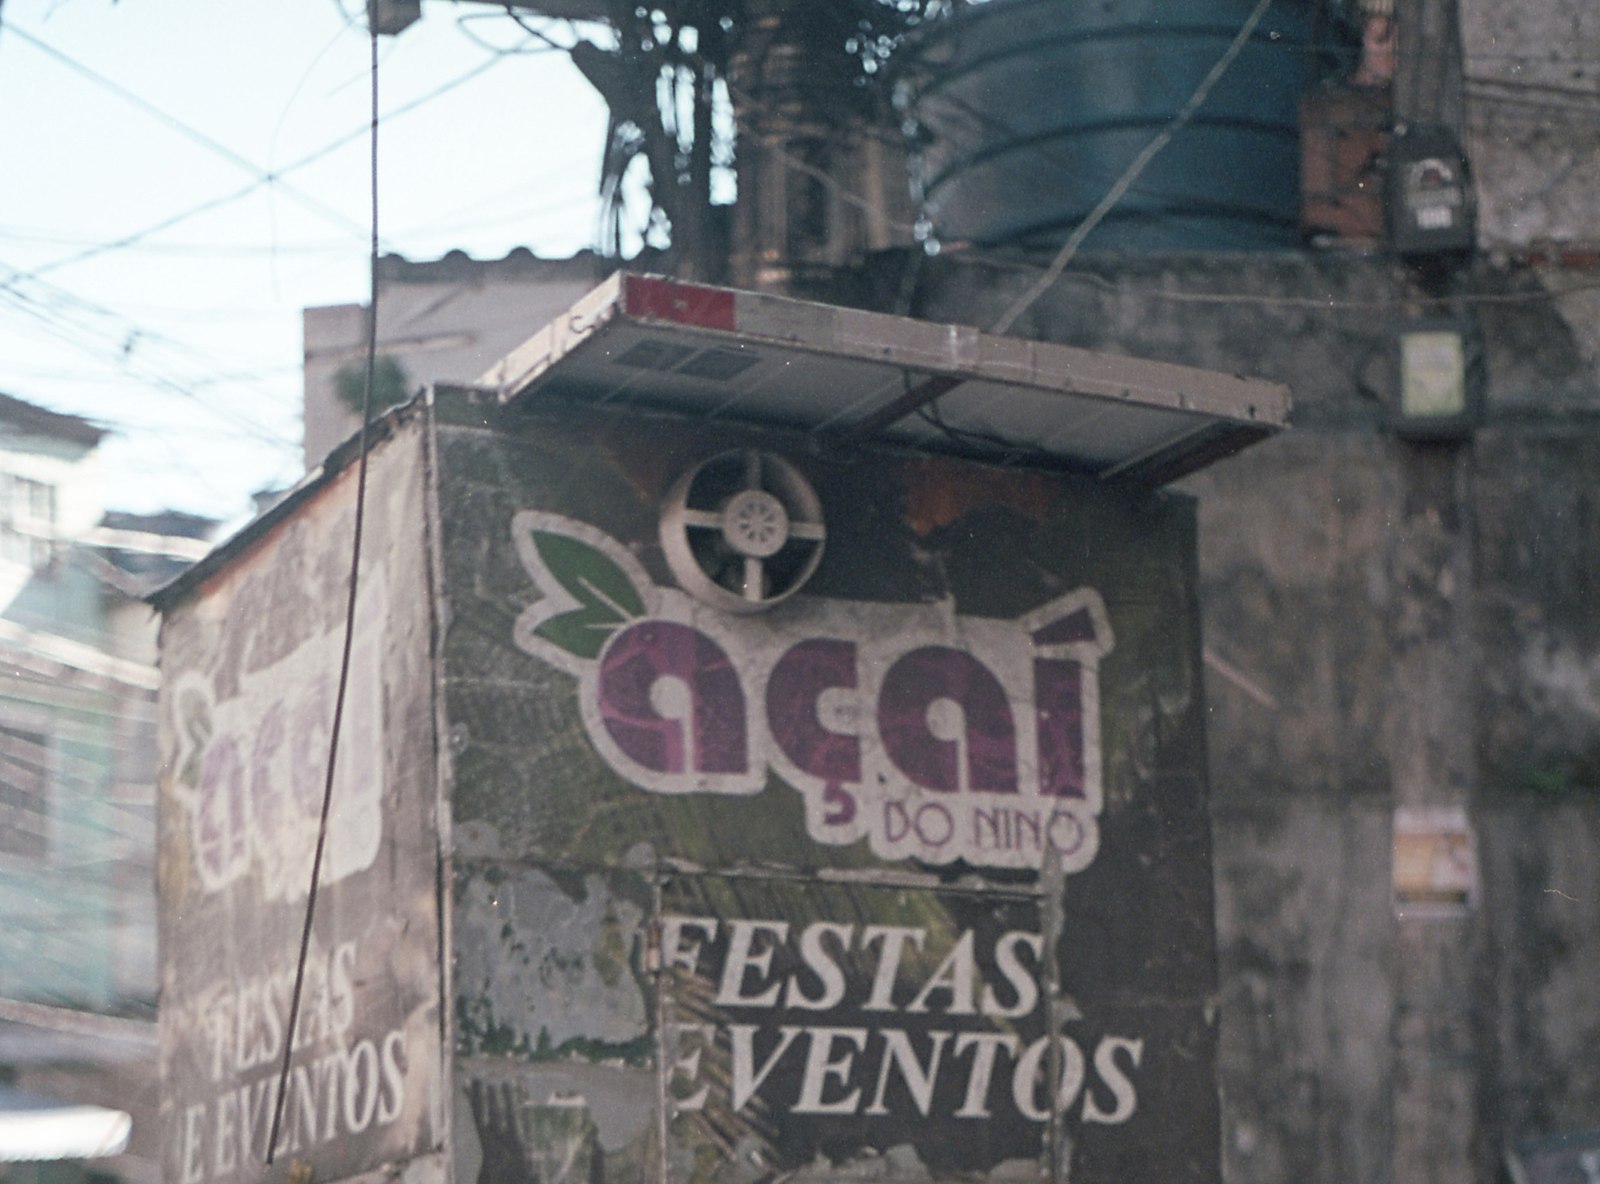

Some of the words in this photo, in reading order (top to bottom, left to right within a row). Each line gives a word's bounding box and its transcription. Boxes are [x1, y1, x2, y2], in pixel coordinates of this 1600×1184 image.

[884, 800, 955, 847] DO
[974, 806, 1084, 855] NINO
[203, 940, 357, 1083] FESAS
[662, 915, 1044, 1019] FESTAS
[665, 1022, 1145, 1125] EVENTOS
